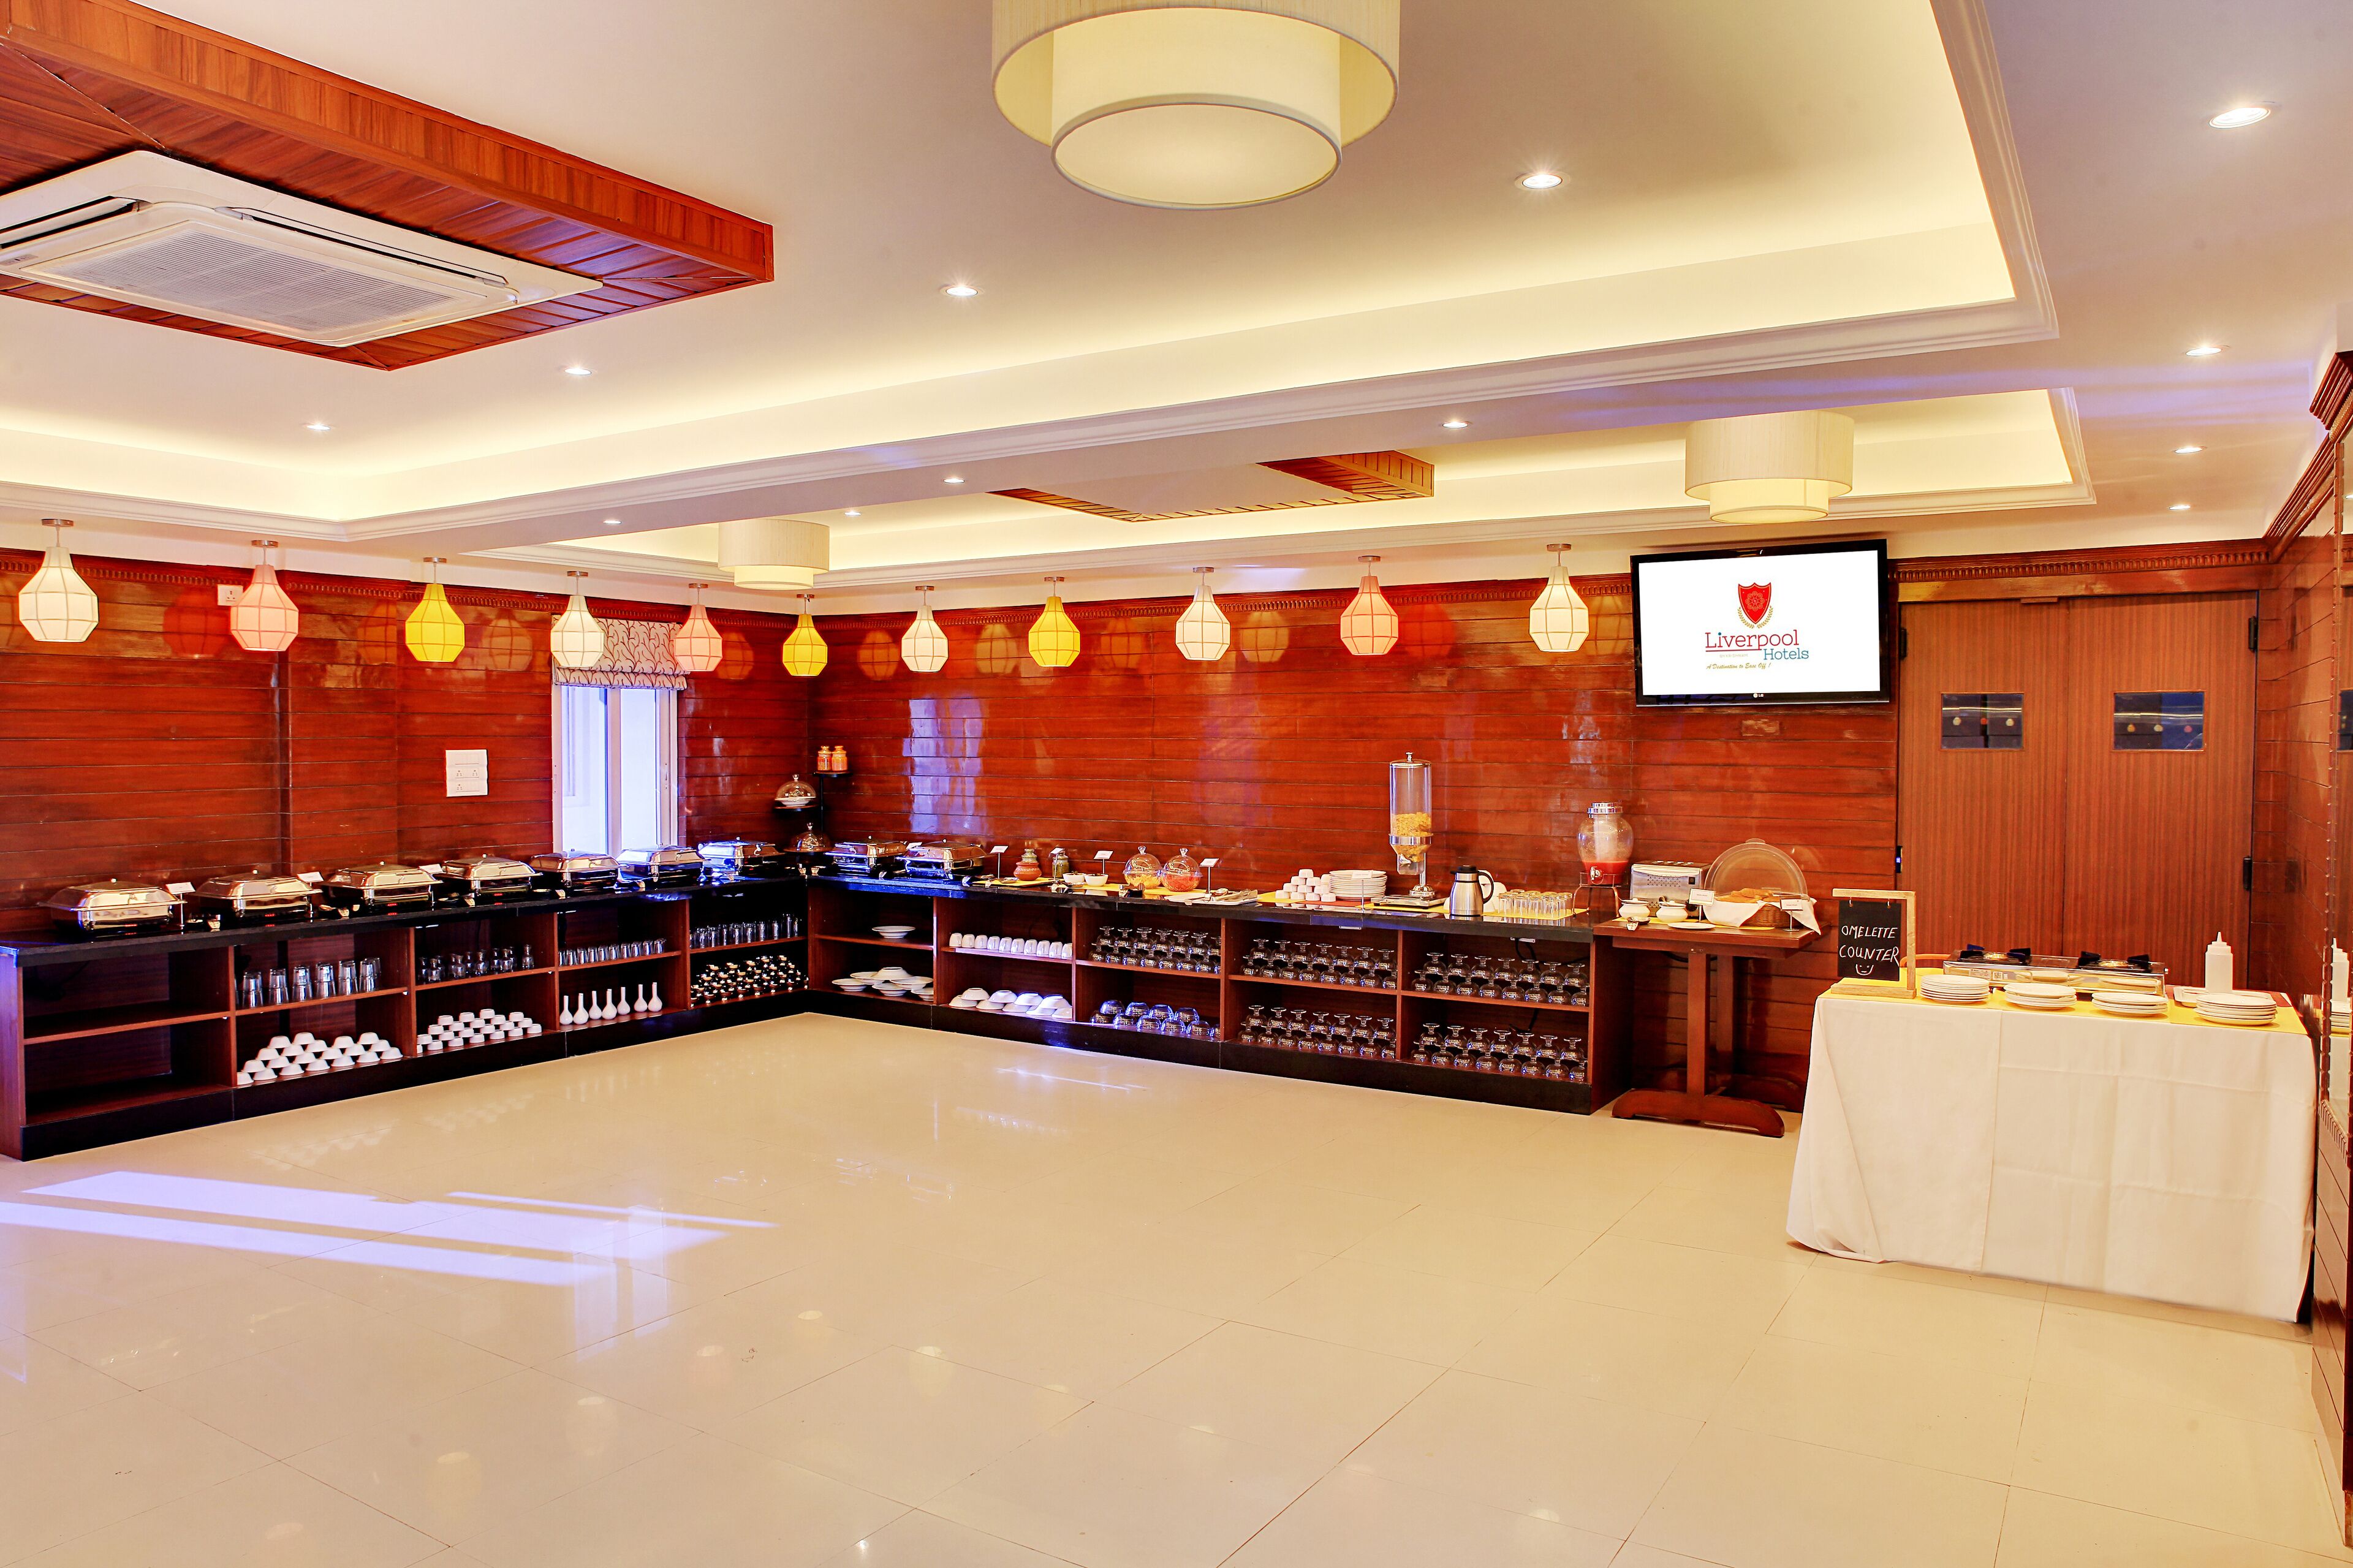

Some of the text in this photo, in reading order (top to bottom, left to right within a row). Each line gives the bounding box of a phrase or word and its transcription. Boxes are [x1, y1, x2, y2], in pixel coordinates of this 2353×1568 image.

[1705, 629, 1800, 651] Liverpool
[1763, 648, 1809, 661] Hotels
[1841, 925, 1898, 939] OMELETTE
[1839, 944, 1900, 967] COUNTER
